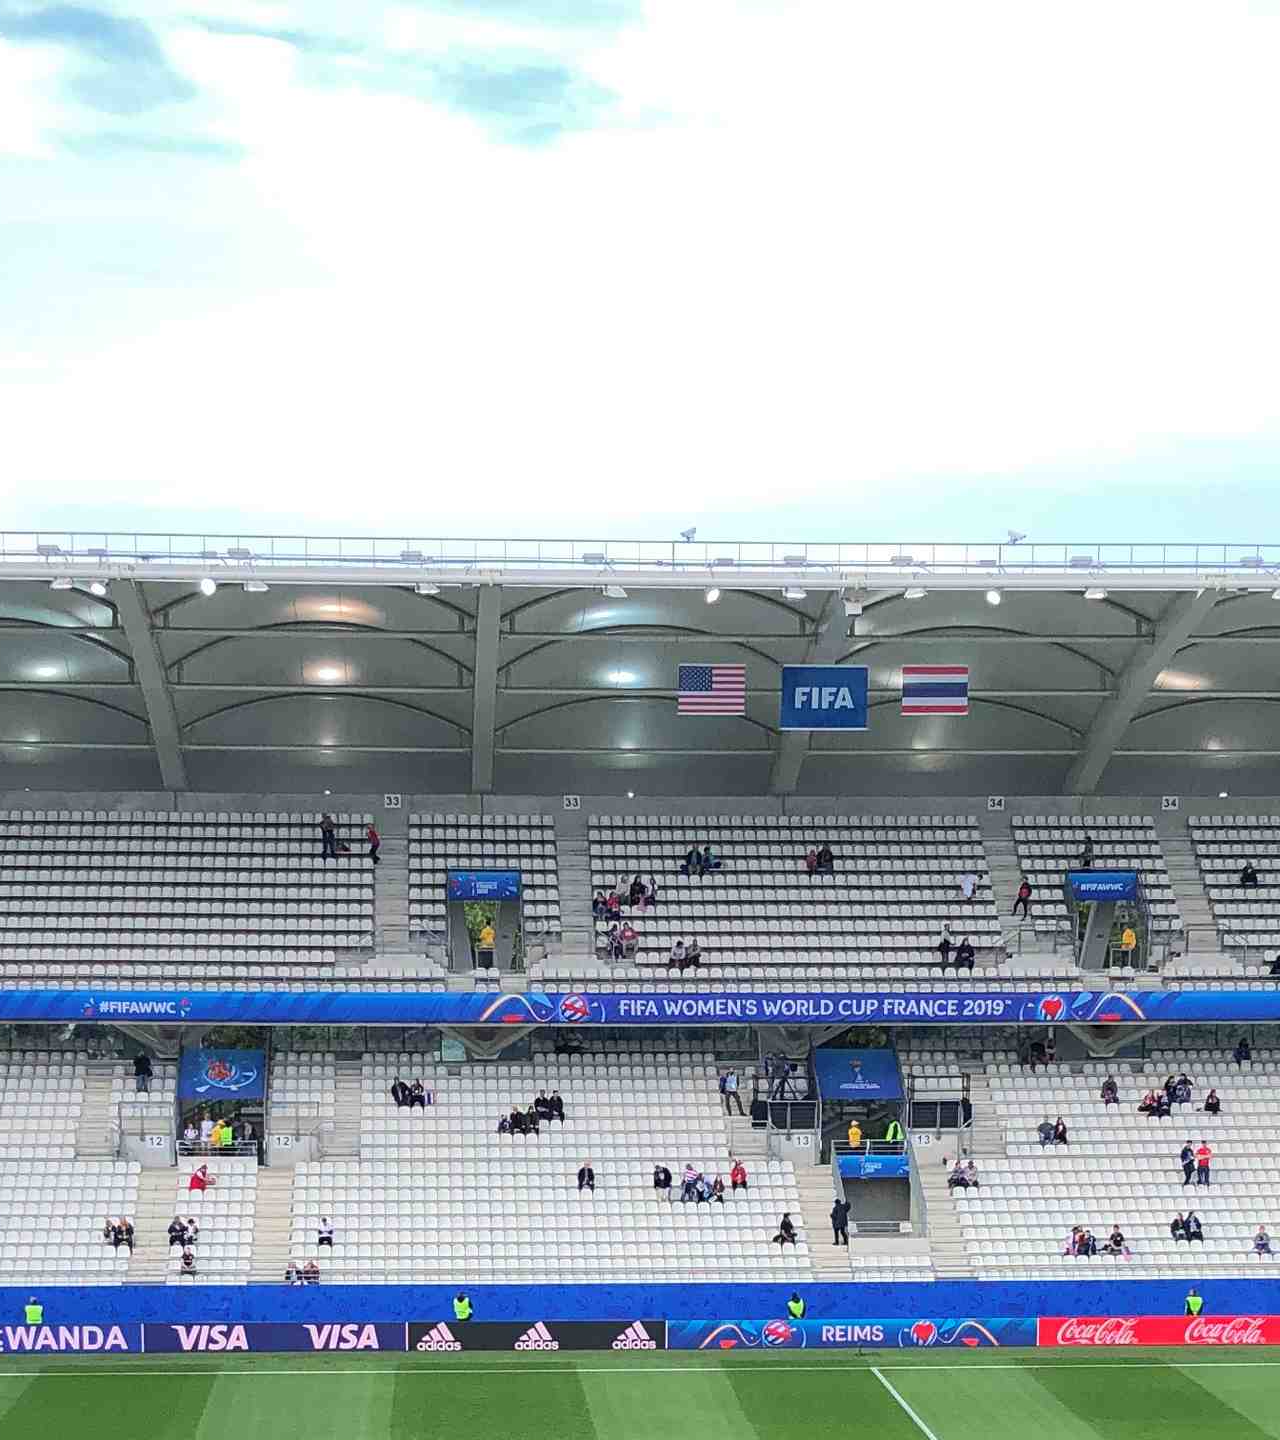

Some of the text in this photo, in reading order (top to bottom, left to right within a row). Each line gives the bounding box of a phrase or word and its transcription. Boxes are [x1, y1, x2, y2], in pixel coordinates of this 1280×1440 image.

[795, 687, 854, 709] FIFA
[386, 796, 400, 806] 33
[565, 798, 579, 807] 33
[990, 798, 1003, 807] 34
[1163, 798, 1177, 807] 34
[100, 1000, 176, 1014] #FIFAWWC
[620, 1000, 658, 1016] FIFA
[663, 999, 757, 1017] WOMEN'S
[763, 1000, 833, 1016] WORLD
[839, 1000, 878, 1016] CUP
[883, 1000, 958, 1017] FRANCE
[149, 1136, 162, 1146] 12
[276, 1136, 290, 1146] 12
[797, 1136, 809, 1146] 13
[918, 1135, 930, 1145] 13
[303, 1324, 379, 1350] VISA
[821, 1323, 884, 1342] REIMS
[1056, 1317, 1140, 1347] Coca-Cola
[1184, 1316, 1266, 1346] Coca-Cola
[172, 1324, 248, 1351] VISA
[417, 1339, 462, 1351] adidas
[514, 1339, 560, 1350] adidas
[612, 1338, 657, 1350] adidas
